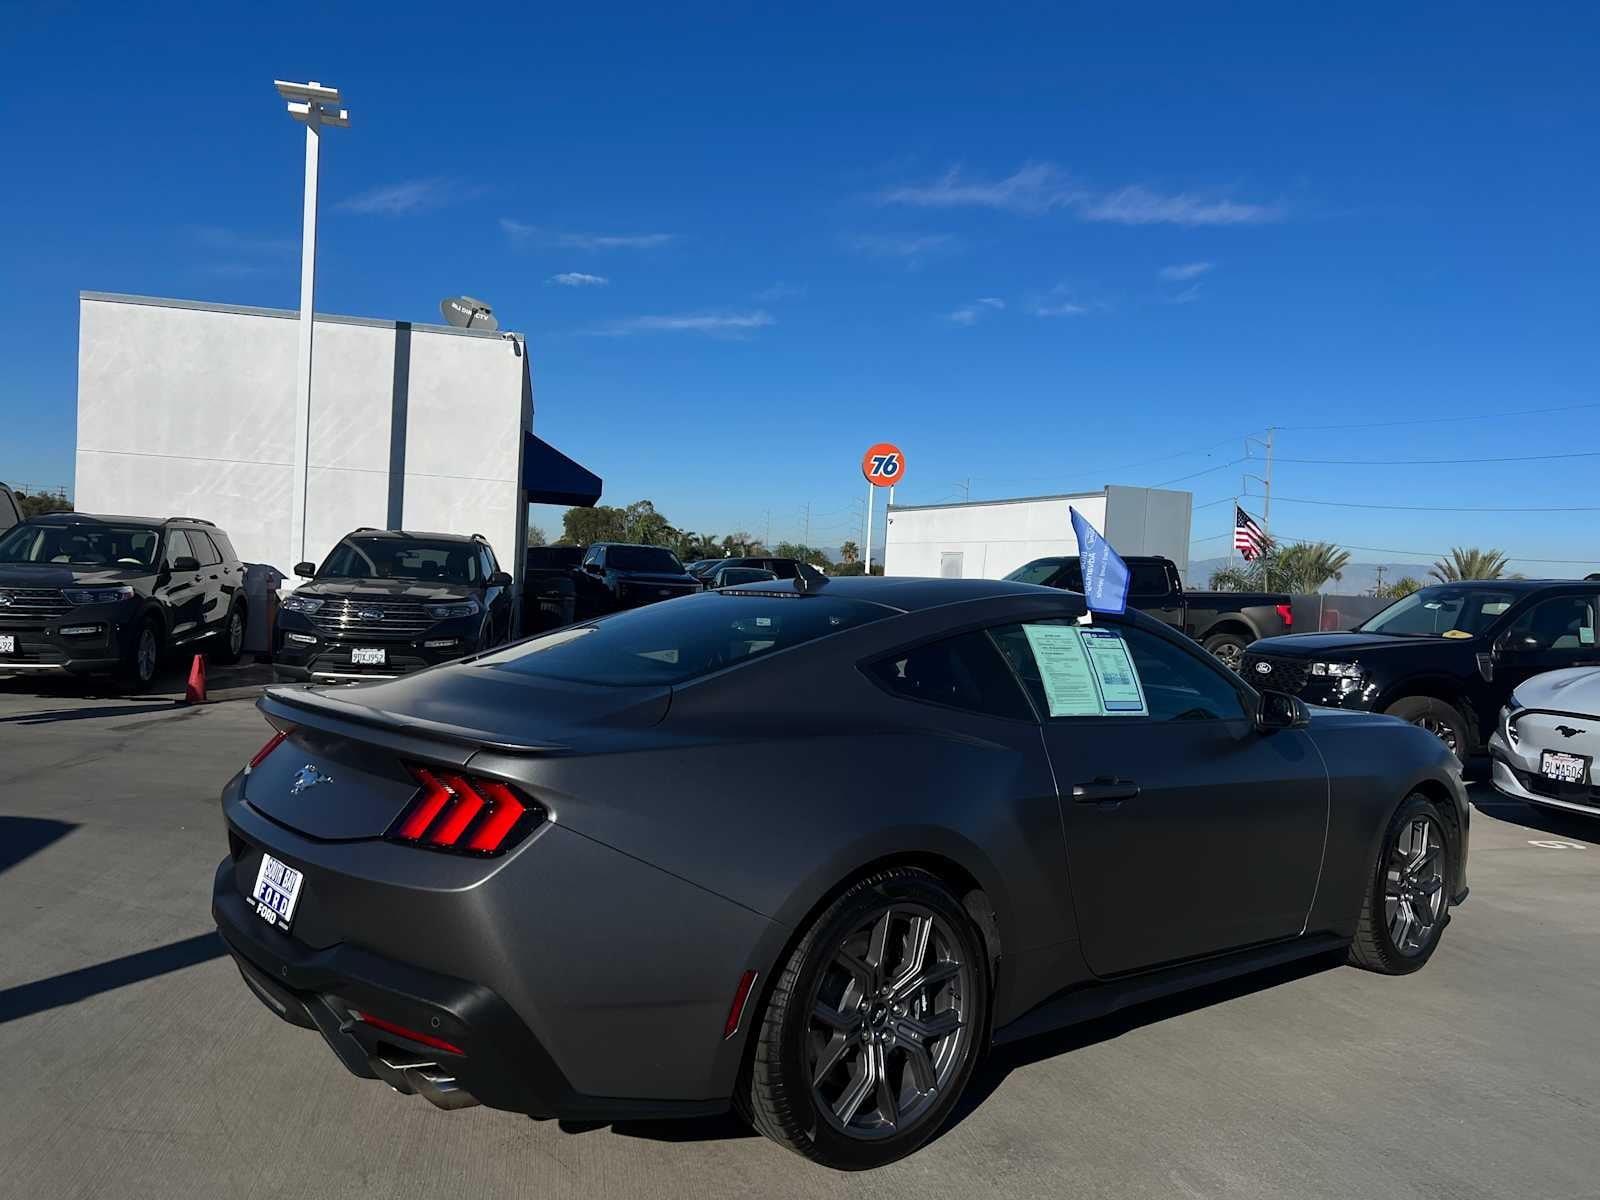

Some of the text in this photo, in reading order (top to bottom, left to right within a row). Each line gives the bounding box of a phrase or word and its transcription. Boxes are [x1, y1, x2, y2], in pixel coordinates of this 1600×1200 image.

[870, 453, 899, 477] 76
[282, 869, 298, 893] BAY
[260, 883, 288, 914] FORD
[256, 902, 277, 925] FORD
